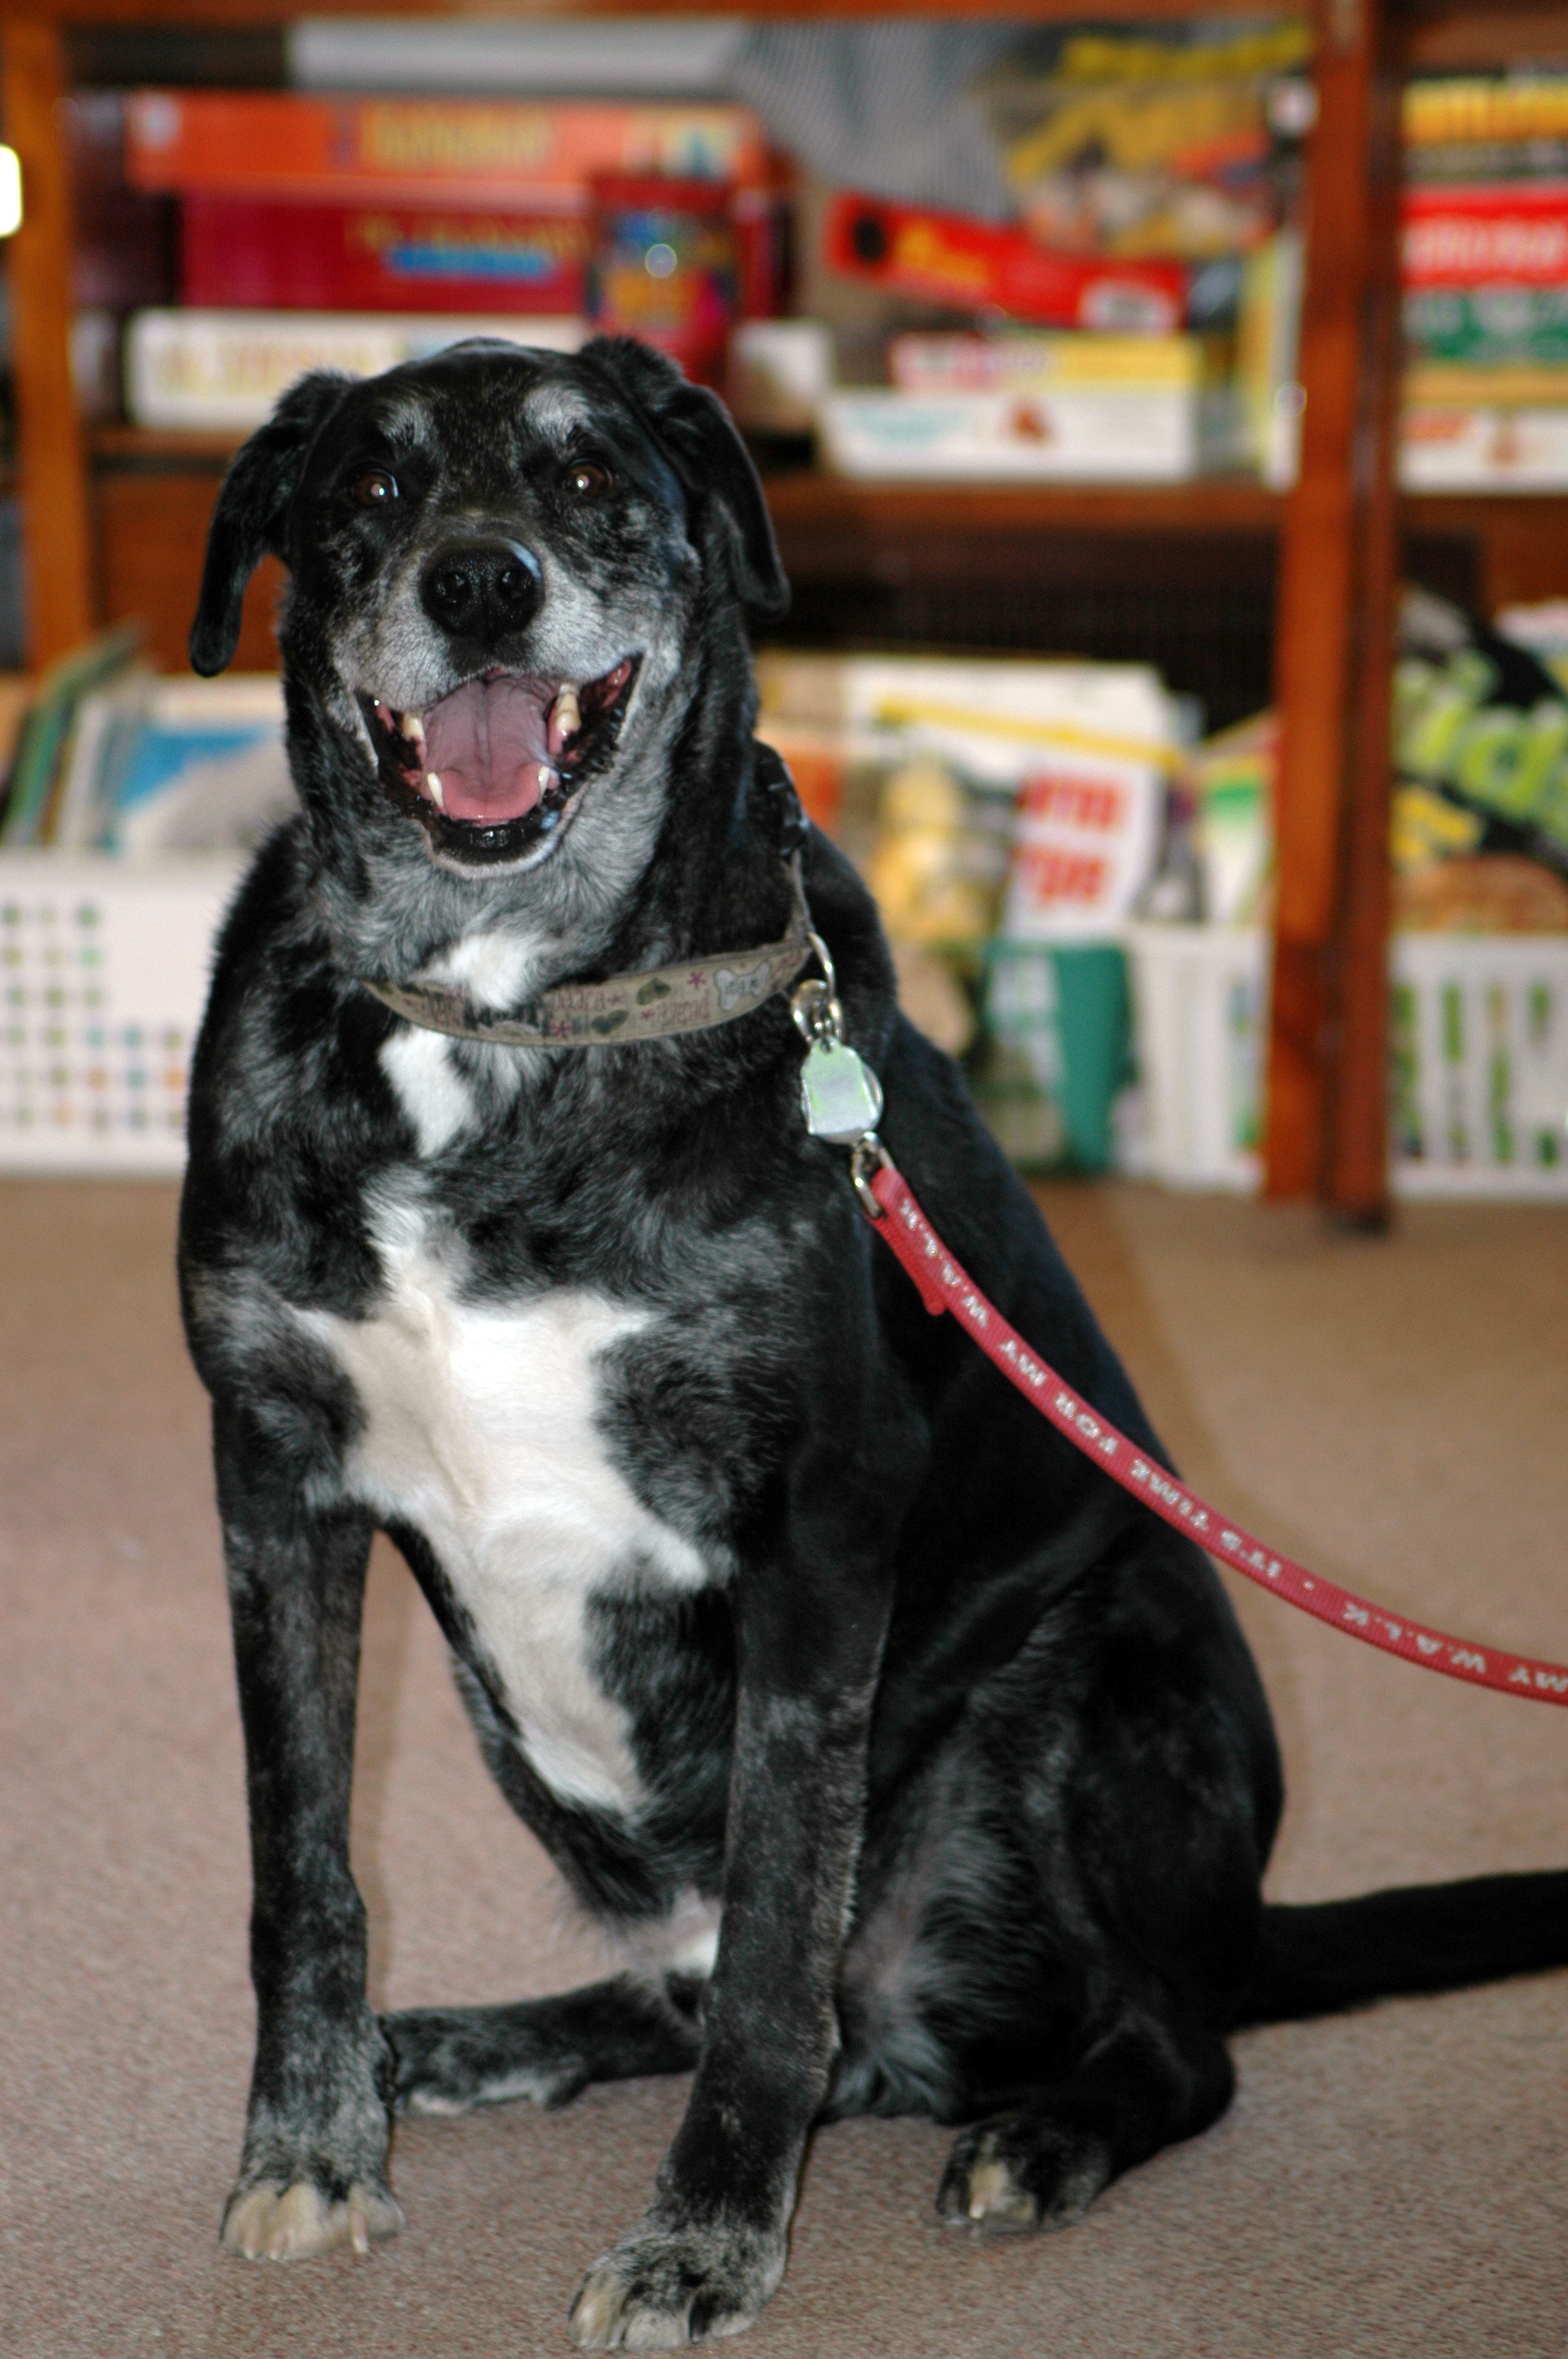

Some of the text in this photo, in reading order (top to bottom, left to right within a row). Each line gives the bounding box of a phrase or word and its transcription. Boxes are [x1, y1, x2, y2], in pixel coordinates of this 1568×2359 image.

[998, 1339, 1047, 1387] MY
[1054, 1392, 1118, 1456] FOR
[1131, 1458, 1209, 1530] TIME
[1220, 1530, 1283, 1579] IT'S
[1508, 1666, 1568, 1692] MY
